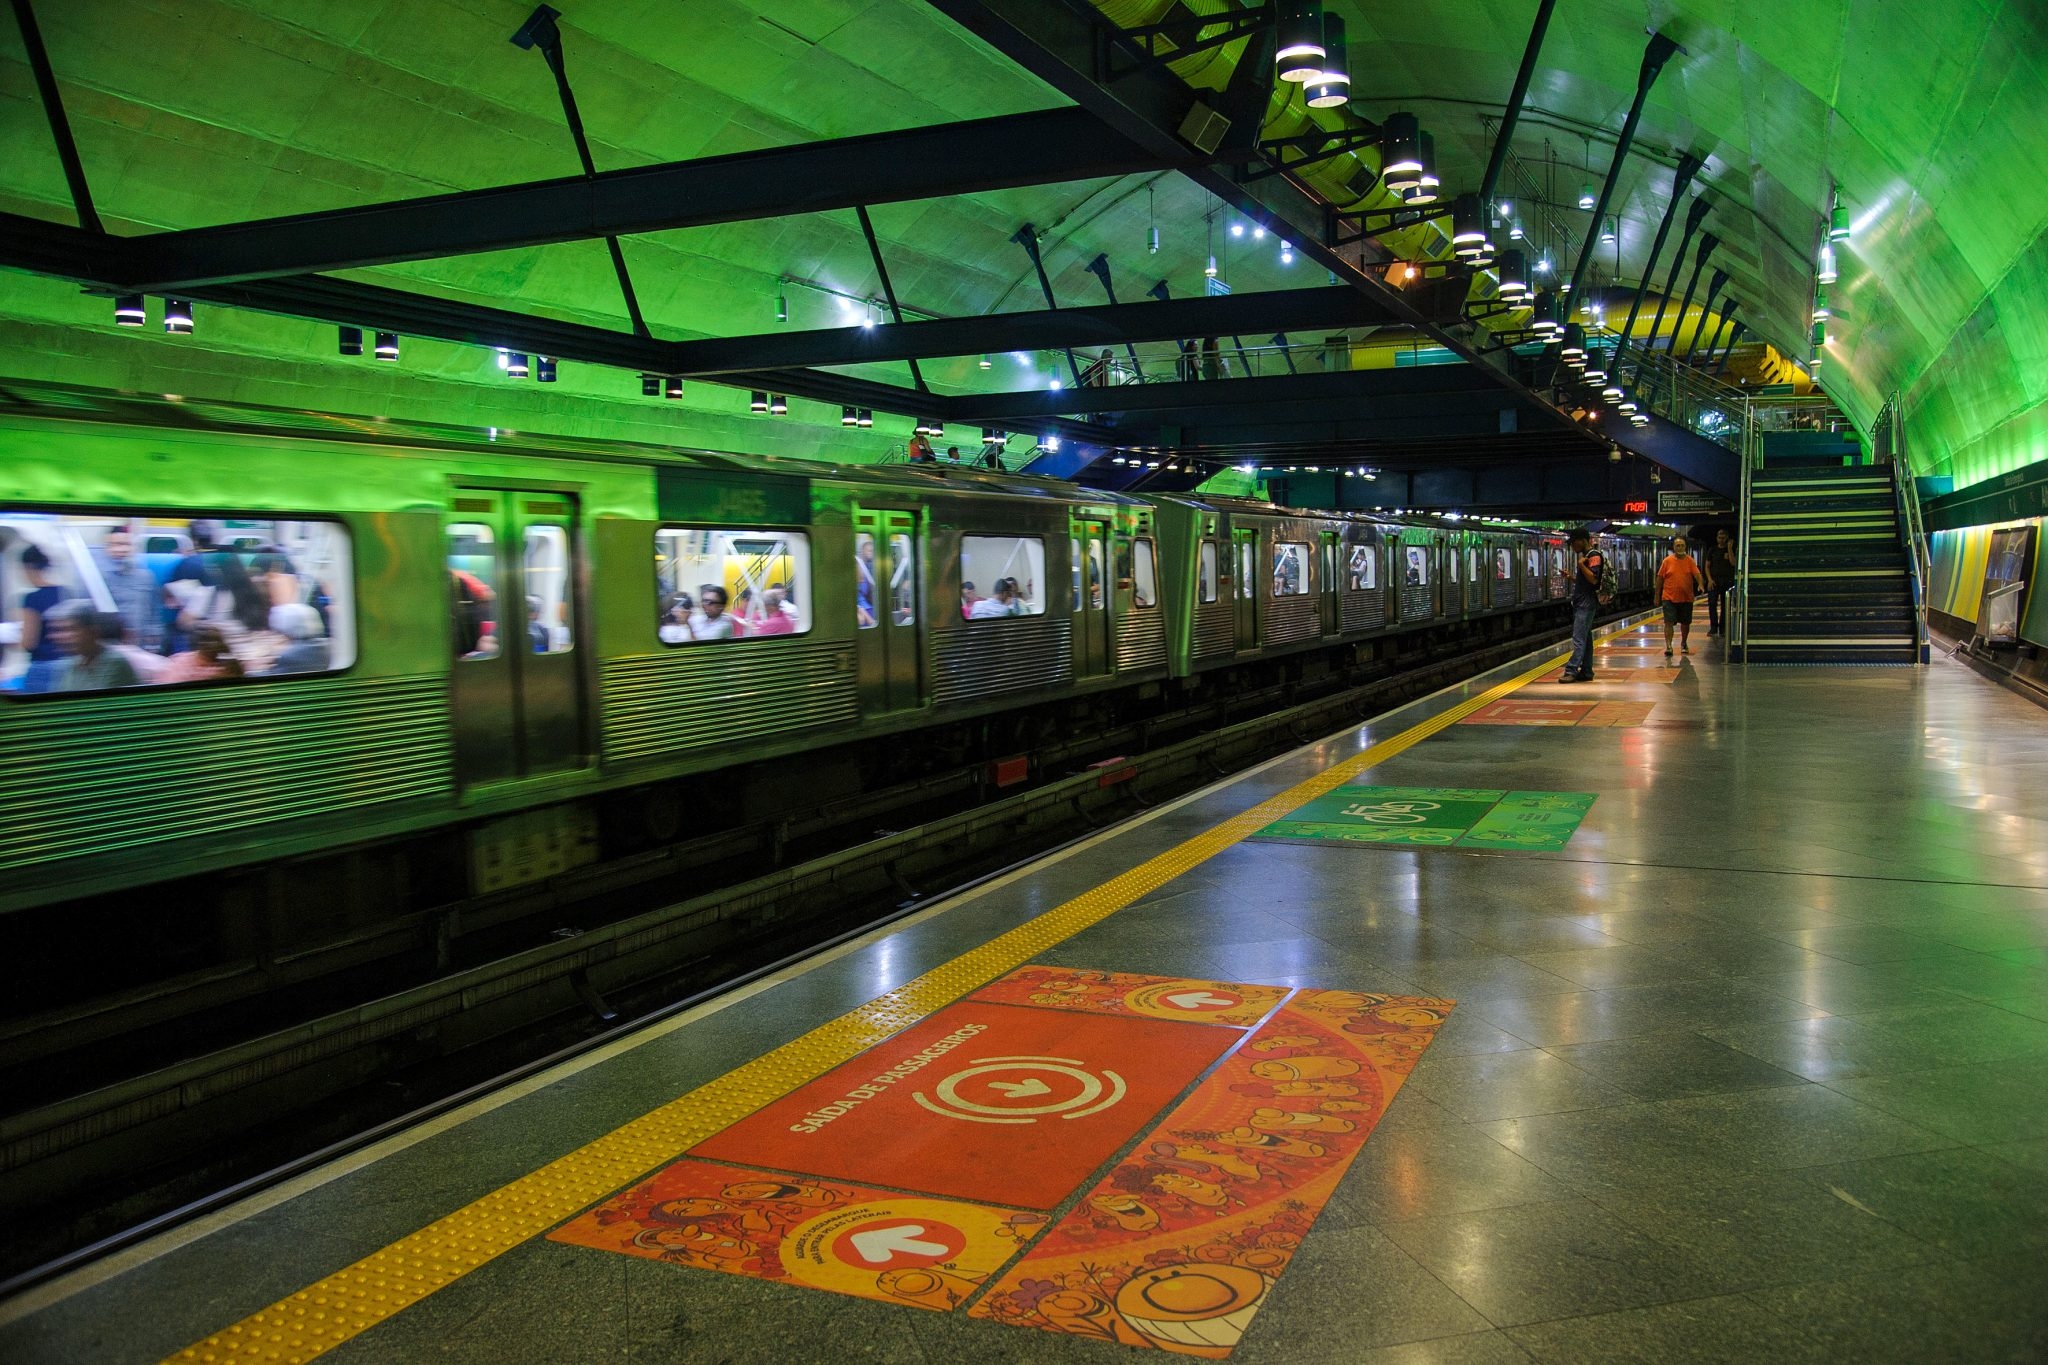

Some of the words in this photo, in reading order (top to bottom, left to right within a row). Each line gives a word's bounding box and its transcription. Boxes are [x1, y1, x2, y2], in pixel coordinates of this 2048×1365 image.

[1625, 502, 1646, 512] 17:09
[1678, 499, 1714, 507] Madalena
[790, 1100, 863, 1134] SAÍDA
[846, 1083, 888, 1102] DE
[872, 1023, 989, 1084] PASSAGEIROS
